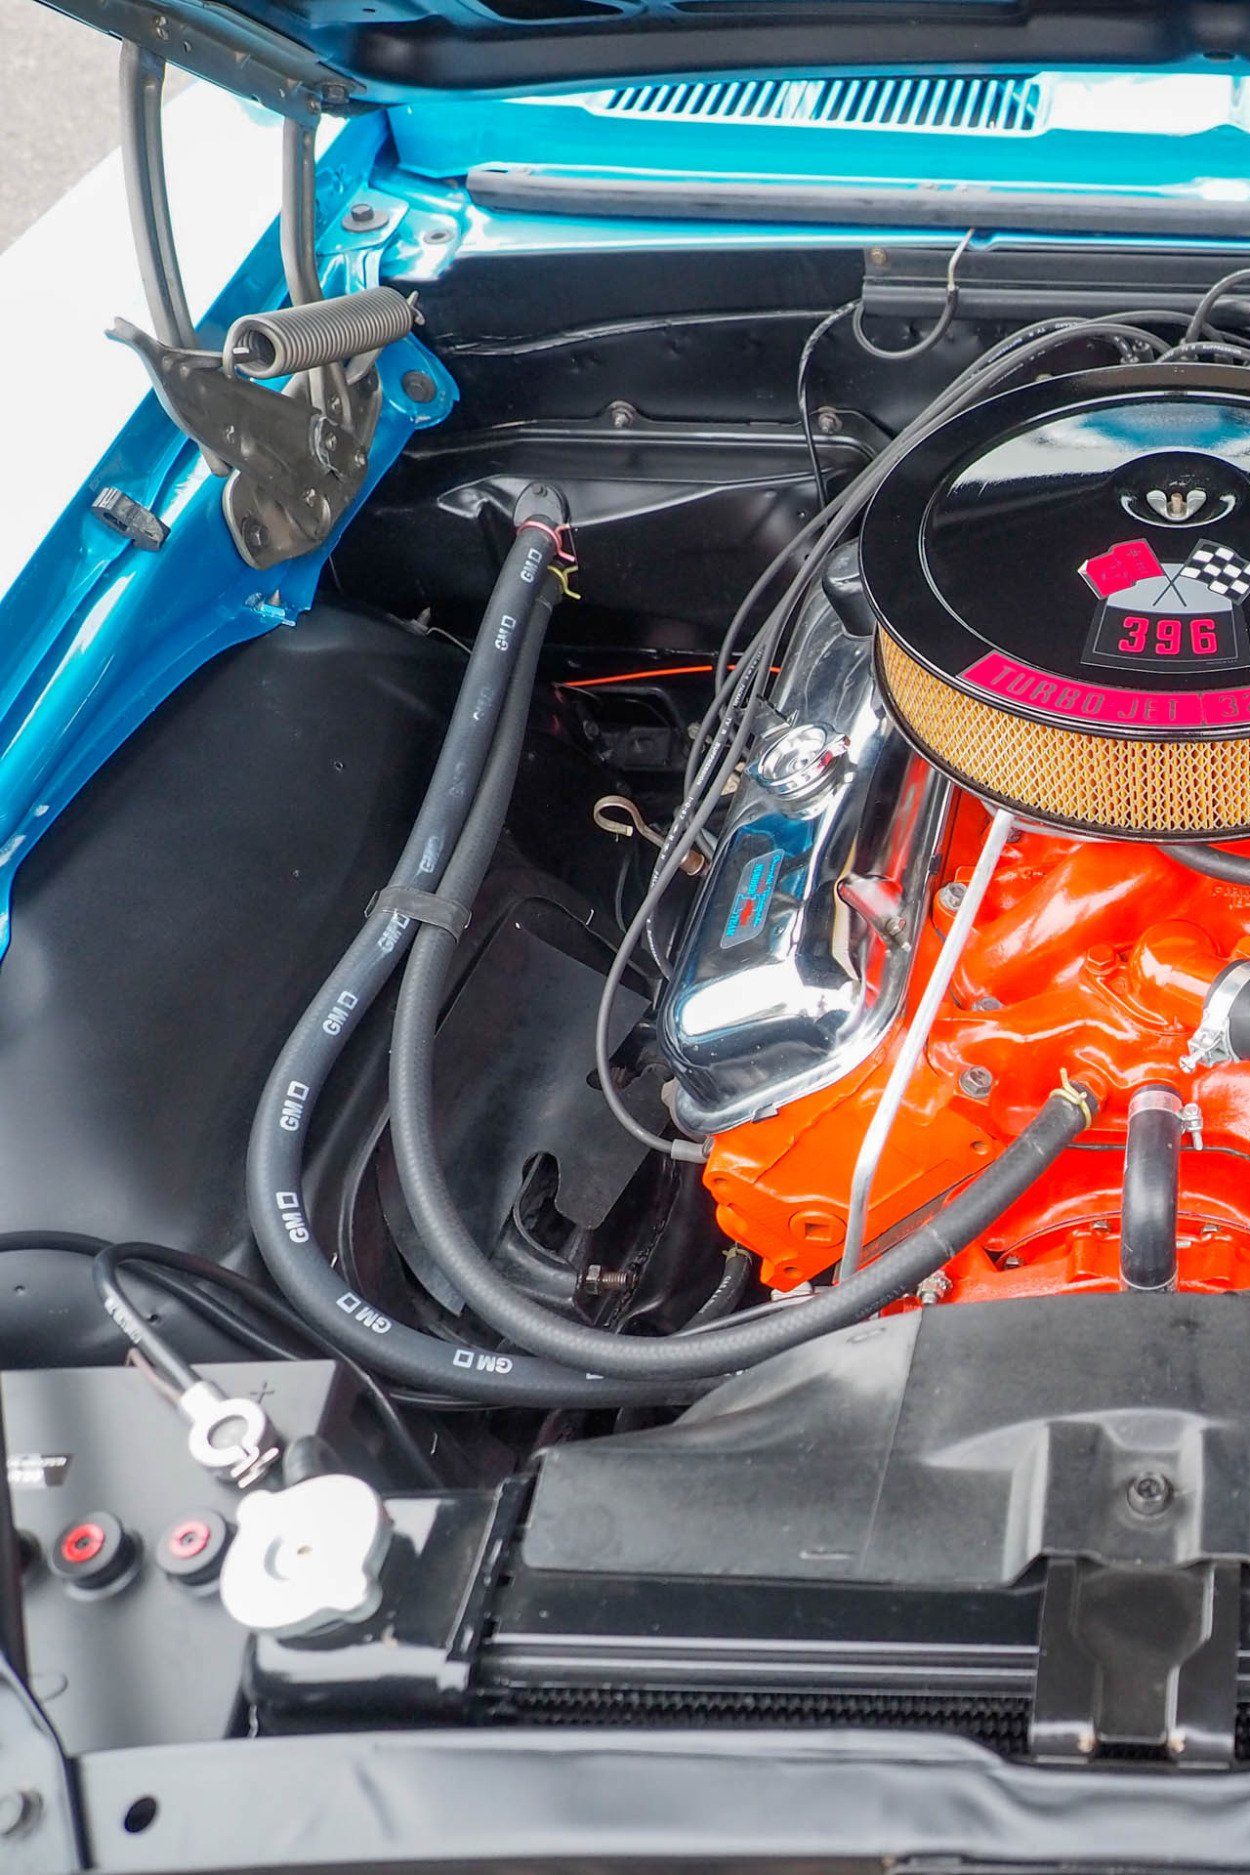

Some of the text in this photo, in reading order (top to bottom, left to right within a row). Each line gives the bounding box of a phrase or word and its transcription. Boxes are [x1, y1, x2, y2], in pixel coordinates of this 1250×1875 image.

[1117, 616, 1218, 655] 396
[992, 665, 1105, 715] TURBO
[1117, 698, 1179, 721] JET
[322, 1006, 349, 1036] GM
[280, 1099, 304, 1132] GM
[281, 1212, 310, 1243] GM
[355, 1307, 392, 1334] GM
[476, 1354, 514, 1374] GM
